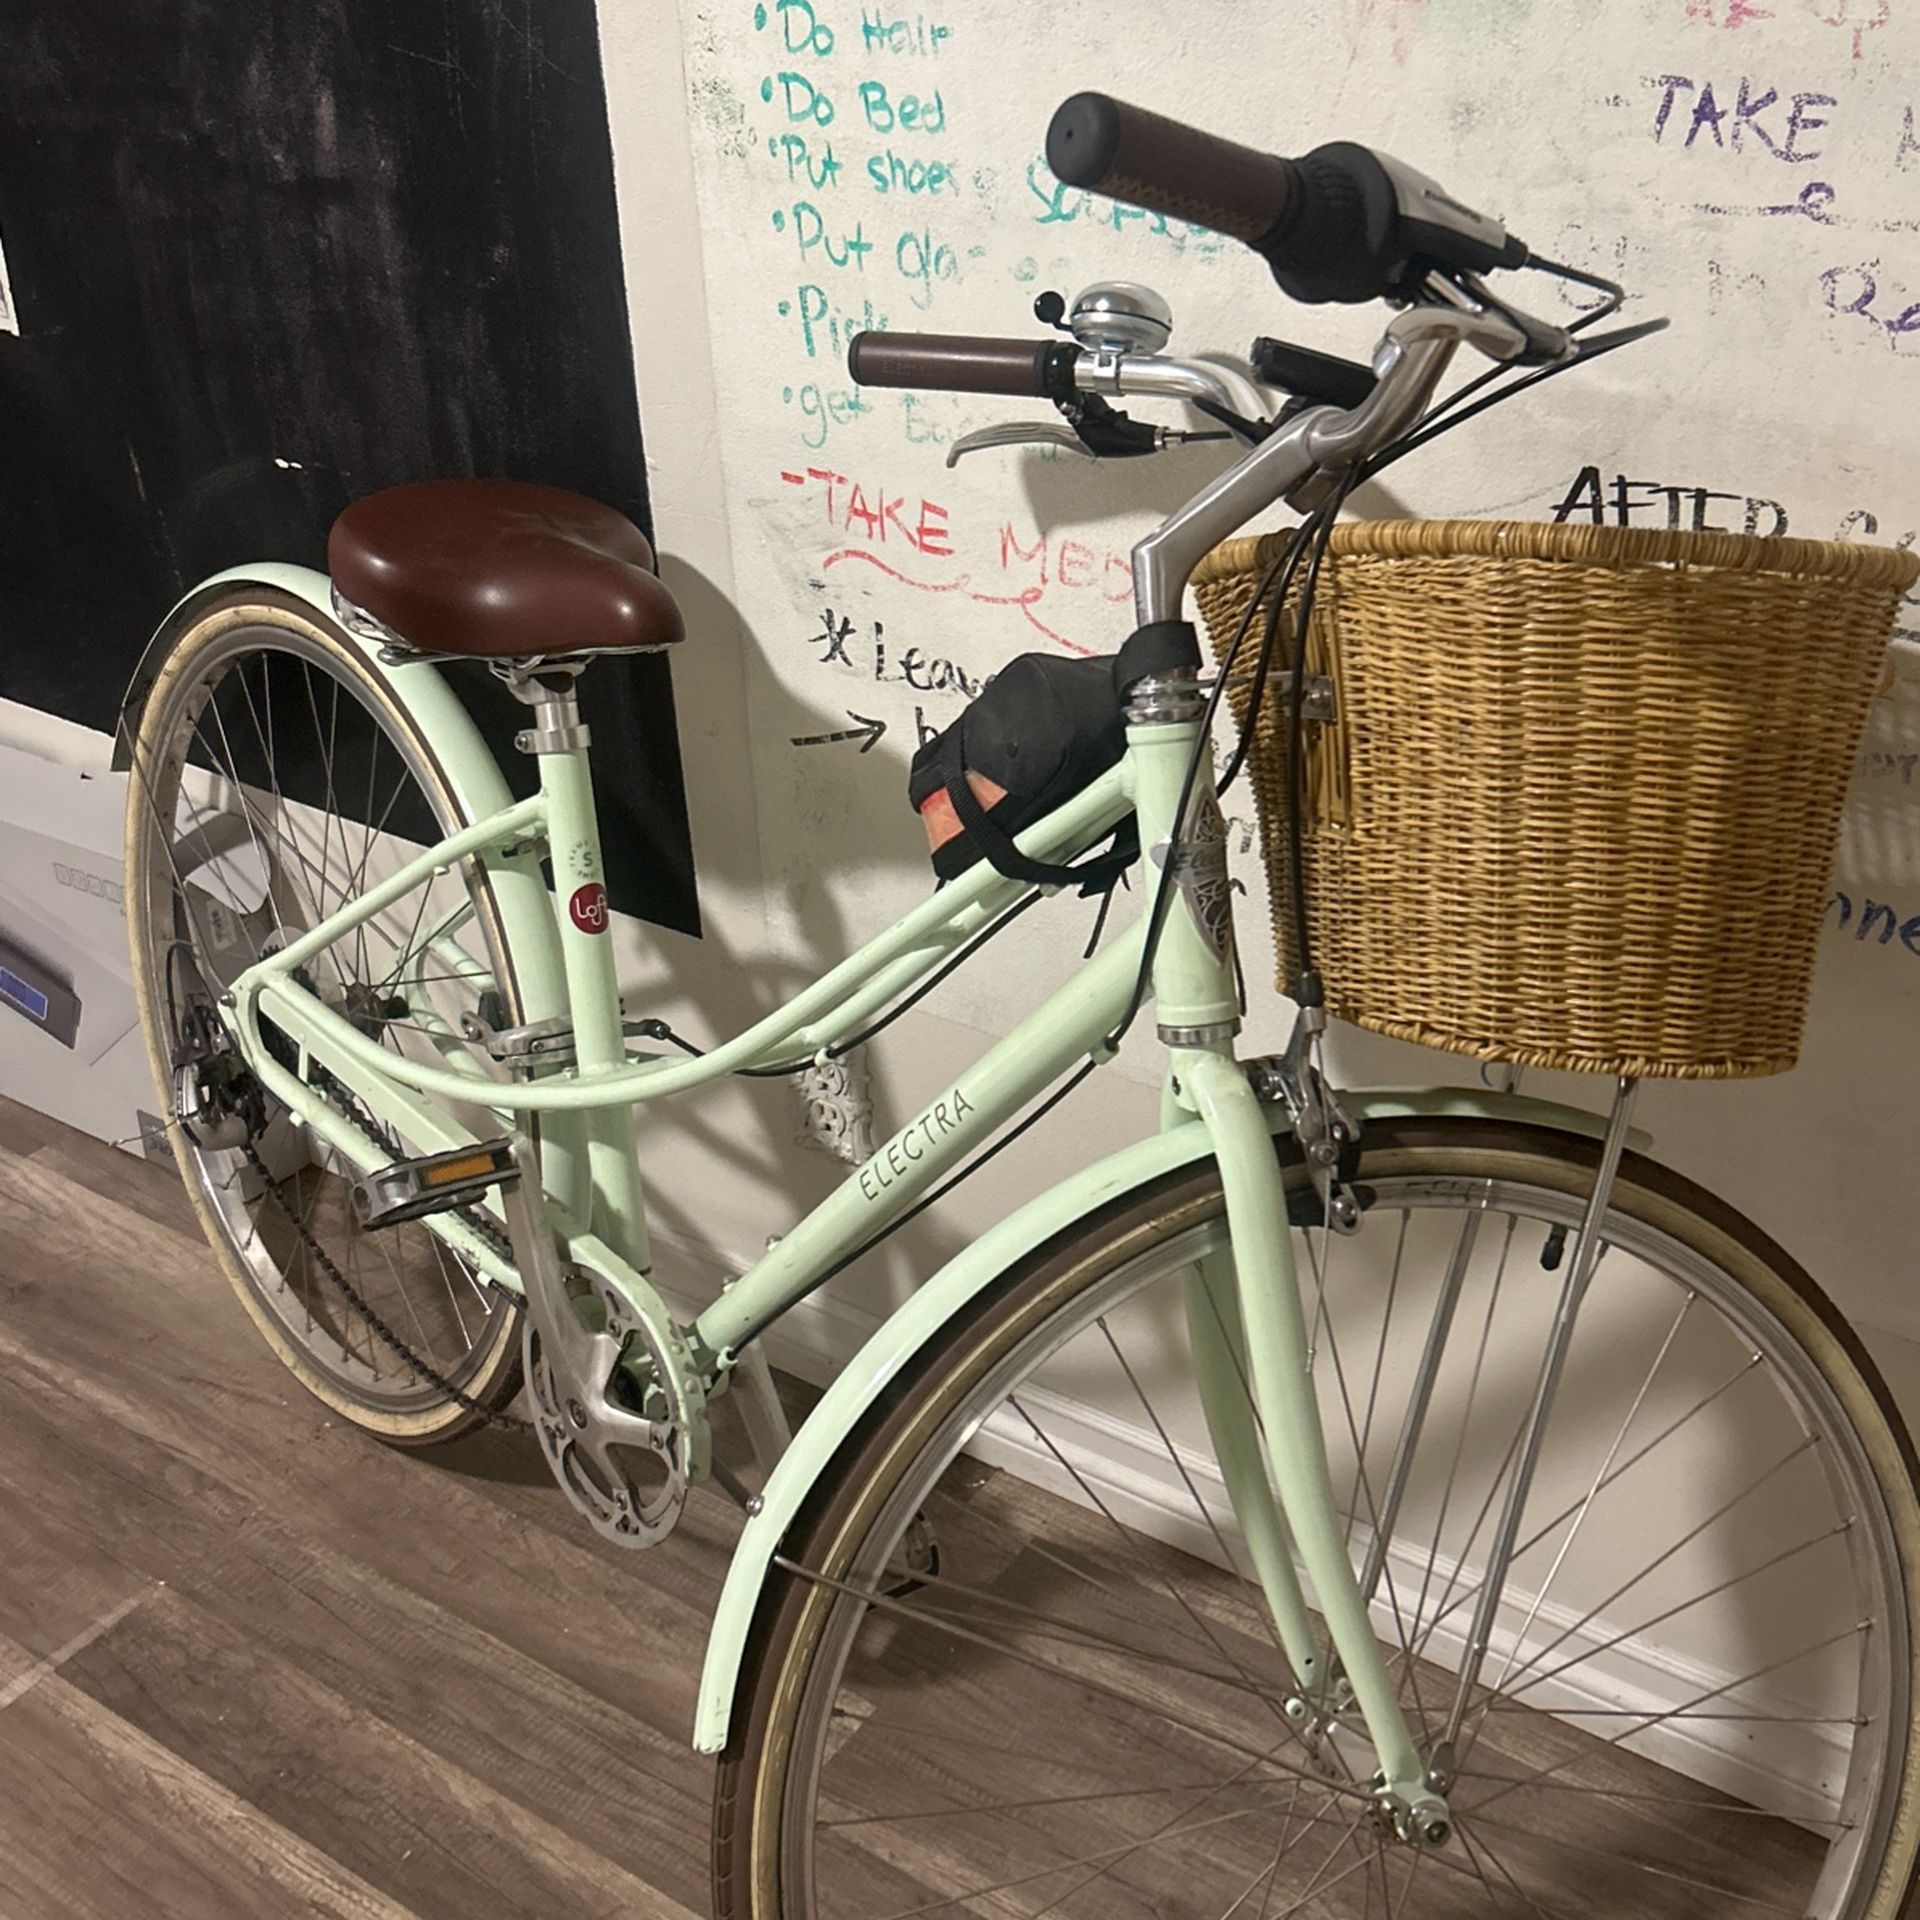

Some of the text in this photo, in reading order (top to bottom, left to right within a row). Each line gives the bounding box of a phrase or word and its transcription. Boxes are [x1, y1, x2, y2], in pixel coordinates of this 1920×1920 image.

[775, 0, 951, 58] Do Hair
[777, 71, 945, 134] Do Bed
[1655, 73, 1838, 163] TAKE
[780, 133, 842, 191] Put
[793, 200, 873, 272] Put
[807, 467, 954, 557] TAKE
[860, 1089, 975, 1201] ELECTRA
